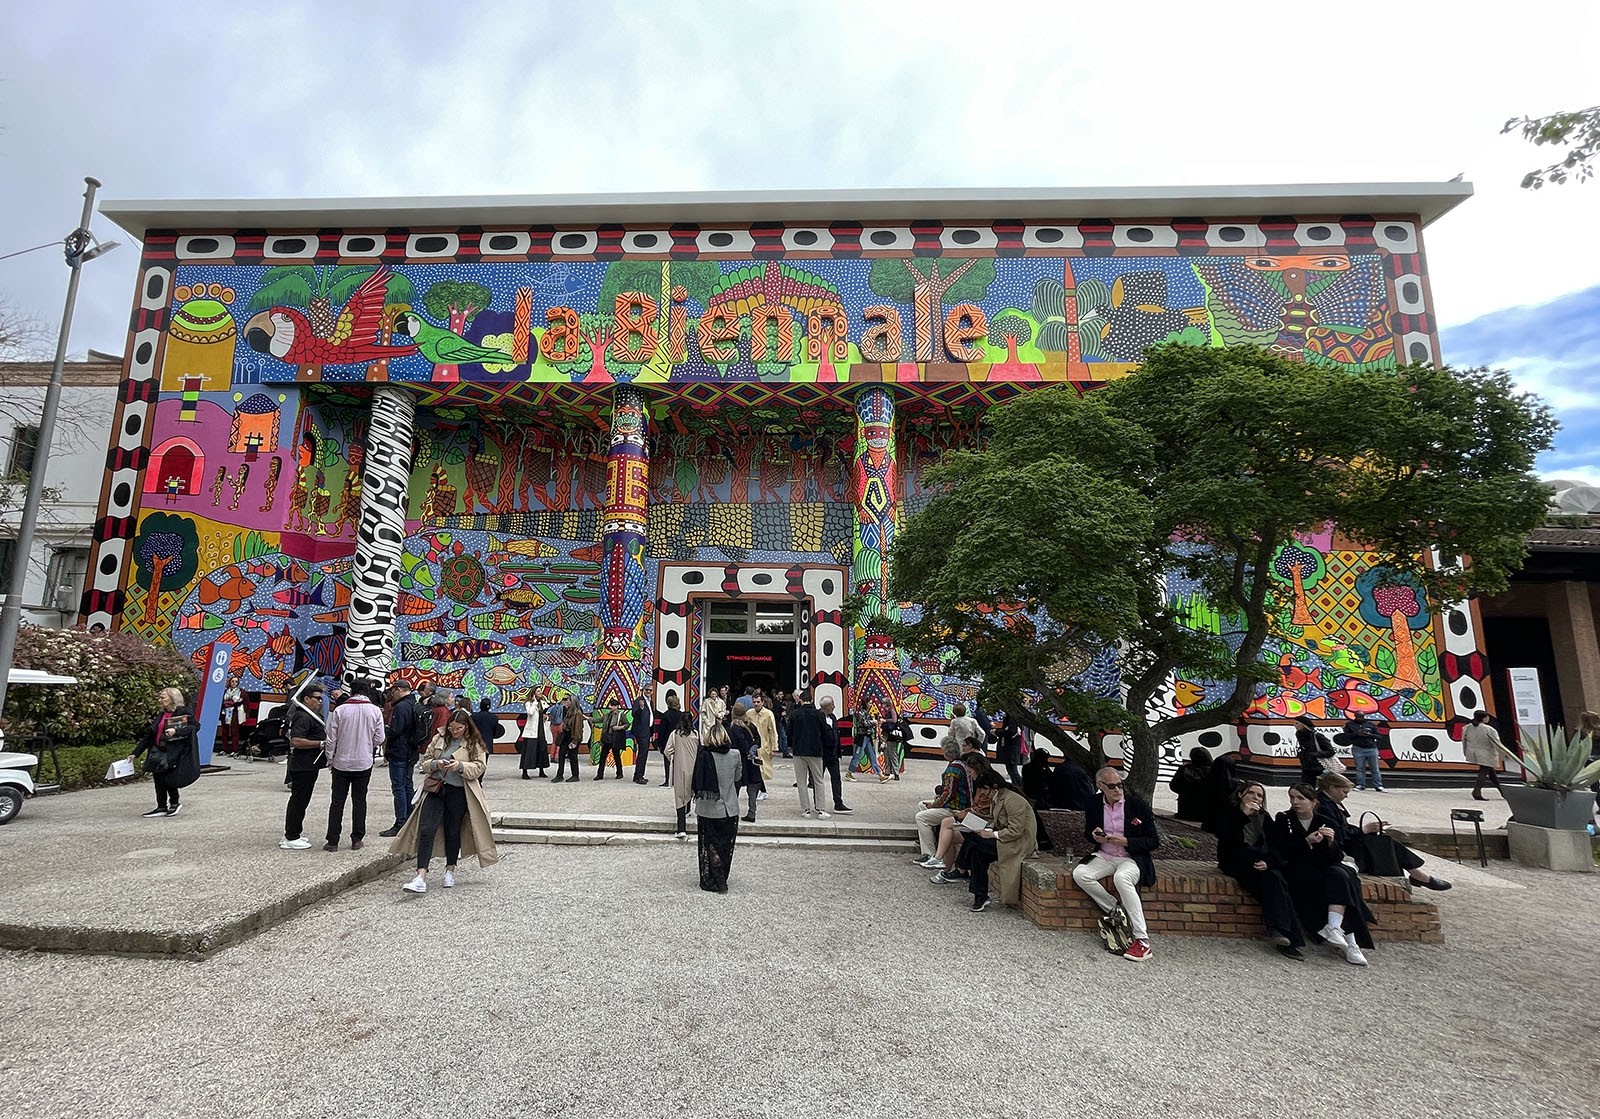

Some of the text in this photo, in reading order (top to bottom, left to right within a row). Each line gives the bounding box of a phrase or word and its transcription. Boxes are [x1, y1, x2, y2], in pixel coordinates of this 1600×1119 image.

[511, 283, 989, 364] la Biennale
[1400, 751, 1444, 763] MAHKU
